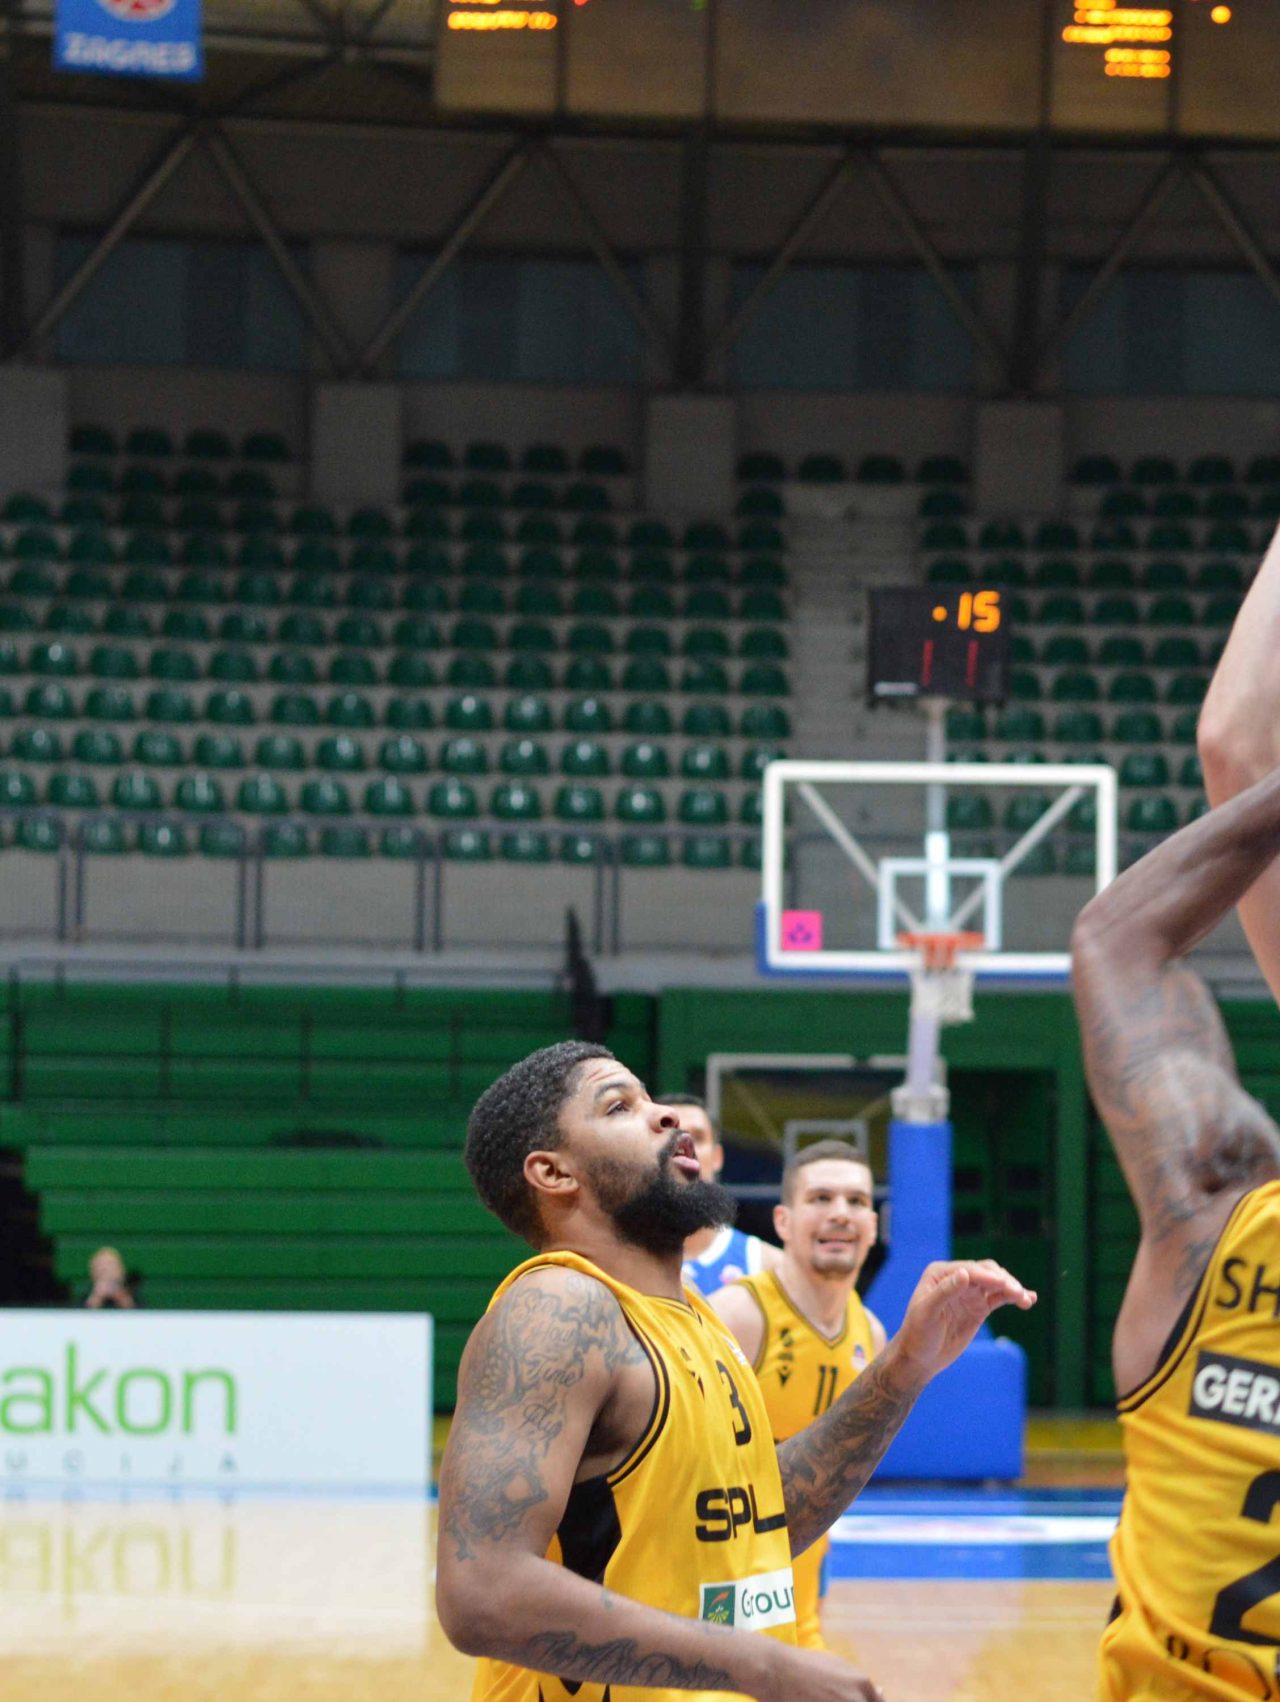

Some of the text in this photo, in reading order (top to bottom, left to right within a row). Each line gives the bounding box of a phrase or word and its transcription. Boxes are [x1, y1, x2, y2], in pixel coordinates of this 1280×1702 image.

[957, 590, 1001, 633] 15
[0, 1341, 238, 1436] akon
[715, 1359, 752, 1446] 3
[813, 1365, 838, 1416] 11
